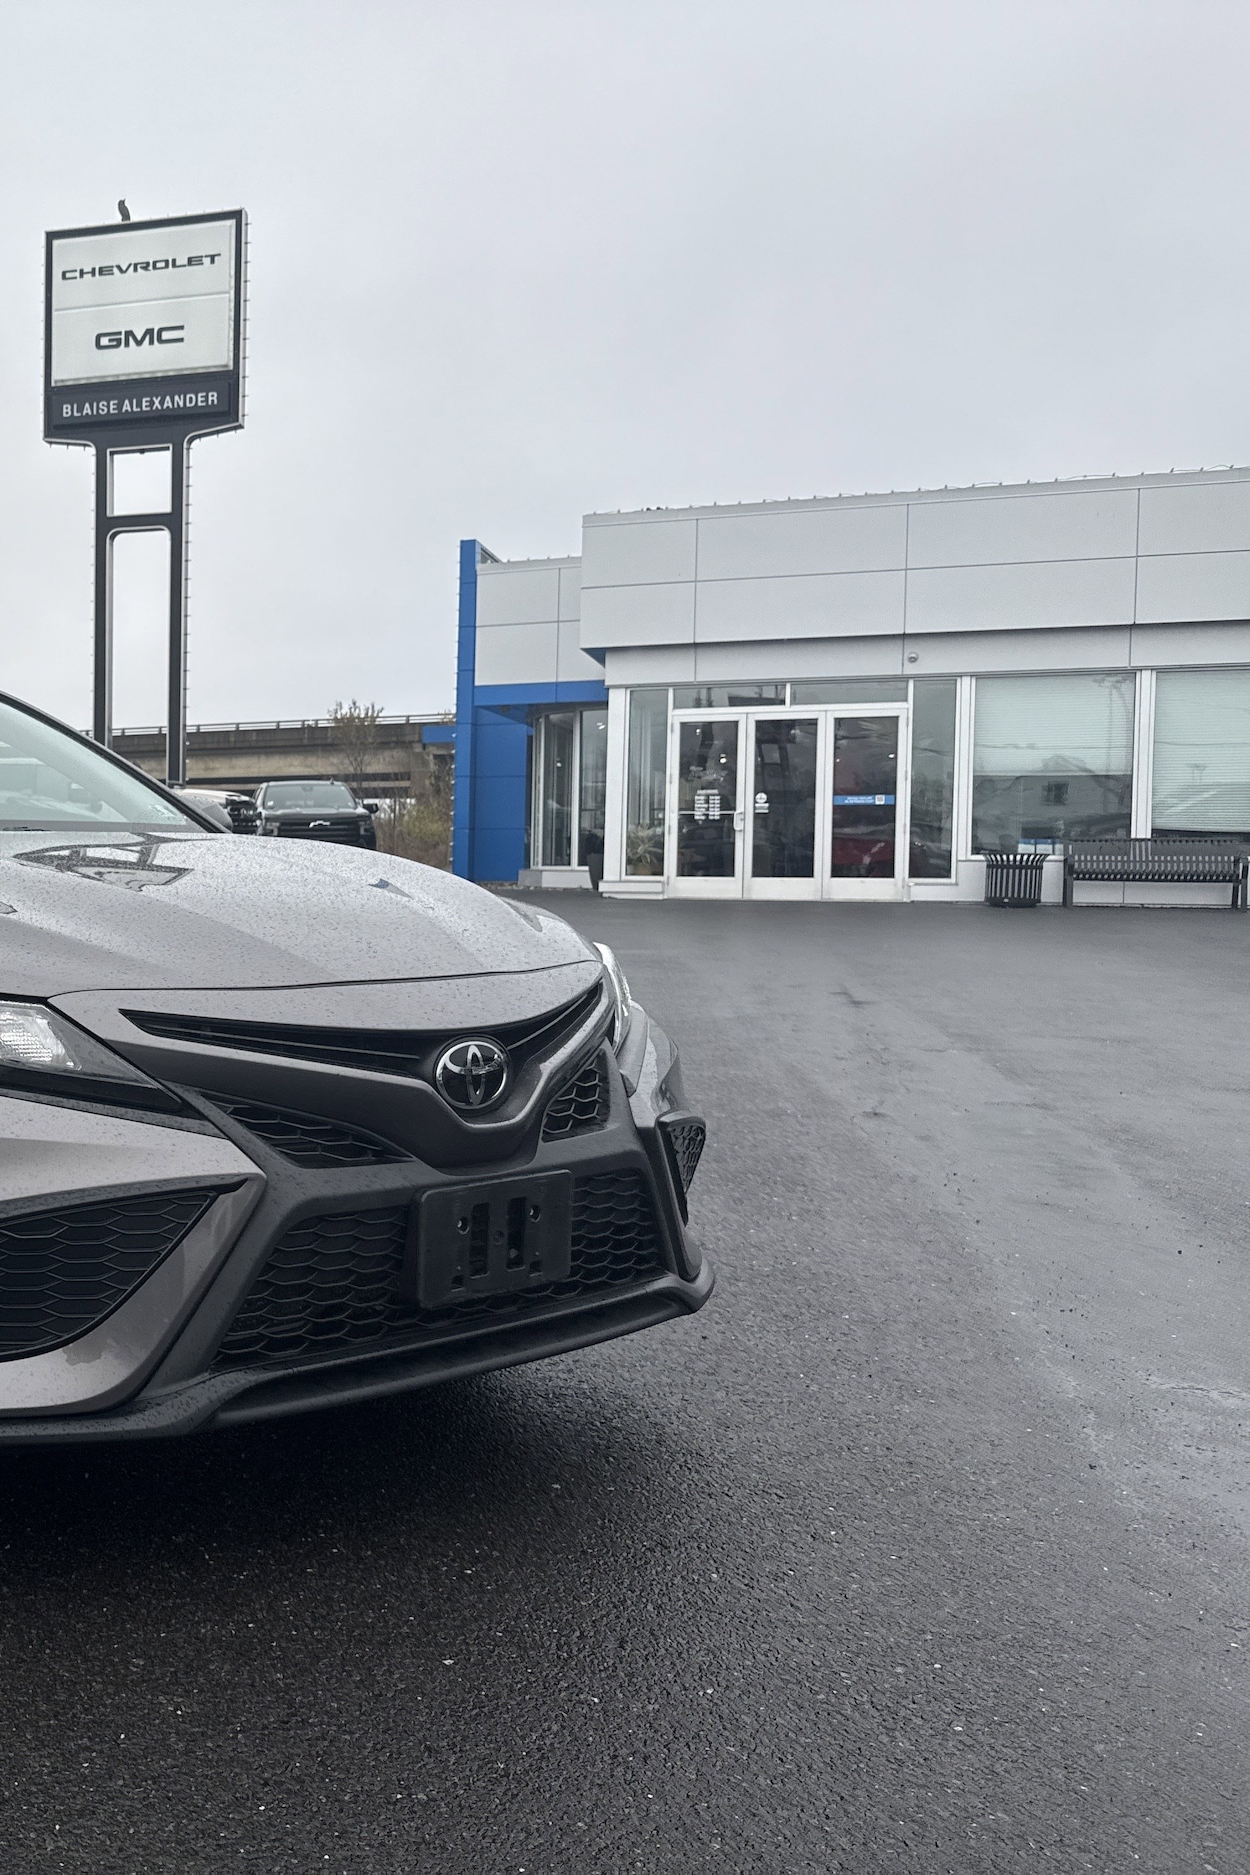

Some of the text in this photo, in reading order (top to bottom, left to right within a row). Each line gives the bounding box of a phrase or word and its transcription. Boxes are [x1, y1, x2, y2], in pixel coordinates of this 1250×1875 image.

[61, 253, 222, 281] CHEVROLET
[95, 325, 185, 351] GMC
[62, 391, 218, 418] BLAISE ALEXANDER
